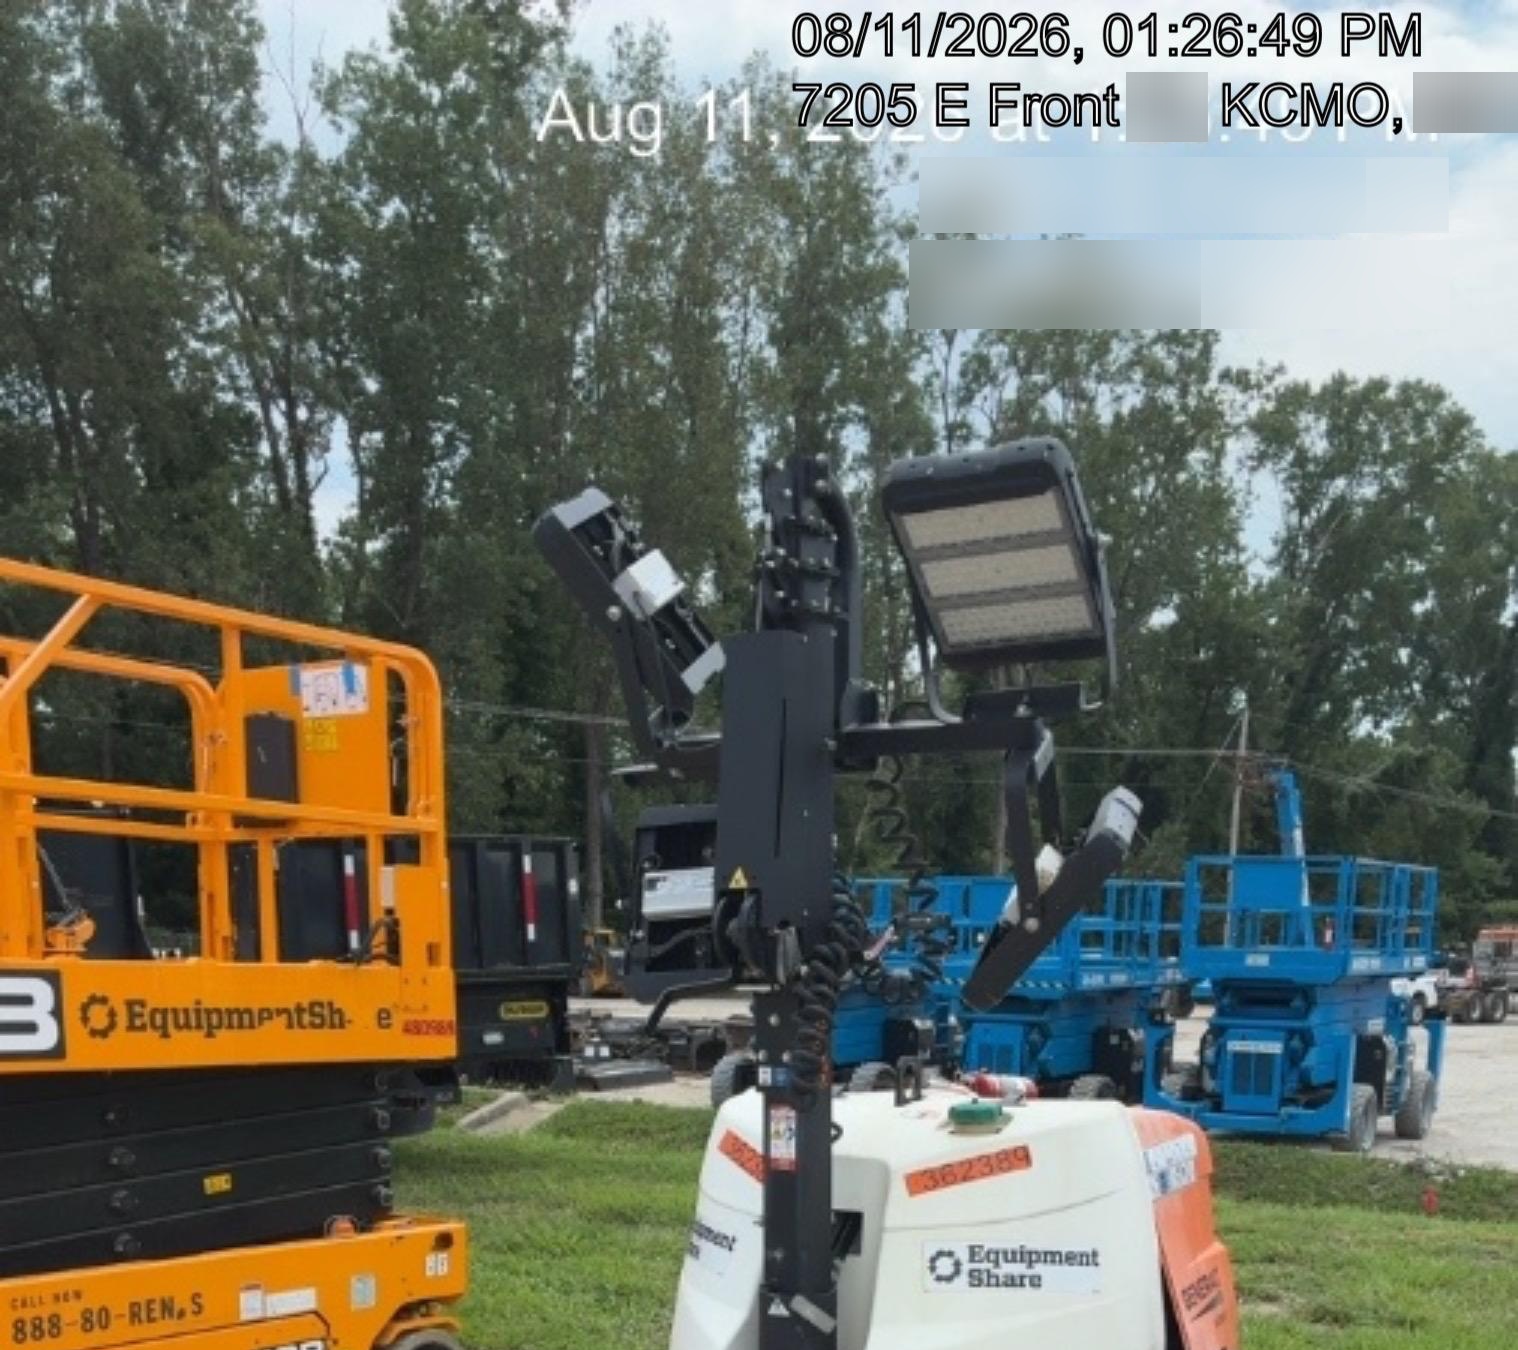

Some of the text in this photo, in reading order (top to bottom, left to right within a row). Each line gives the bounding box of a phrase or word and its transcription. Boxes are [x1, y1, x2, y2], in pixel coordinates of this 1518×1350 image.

[967, 1244, 1100, 1269] Equipment
[968, 1268, 1043, 1288] Share
[12, 1292, 205, 1344] 888-80-RENS
